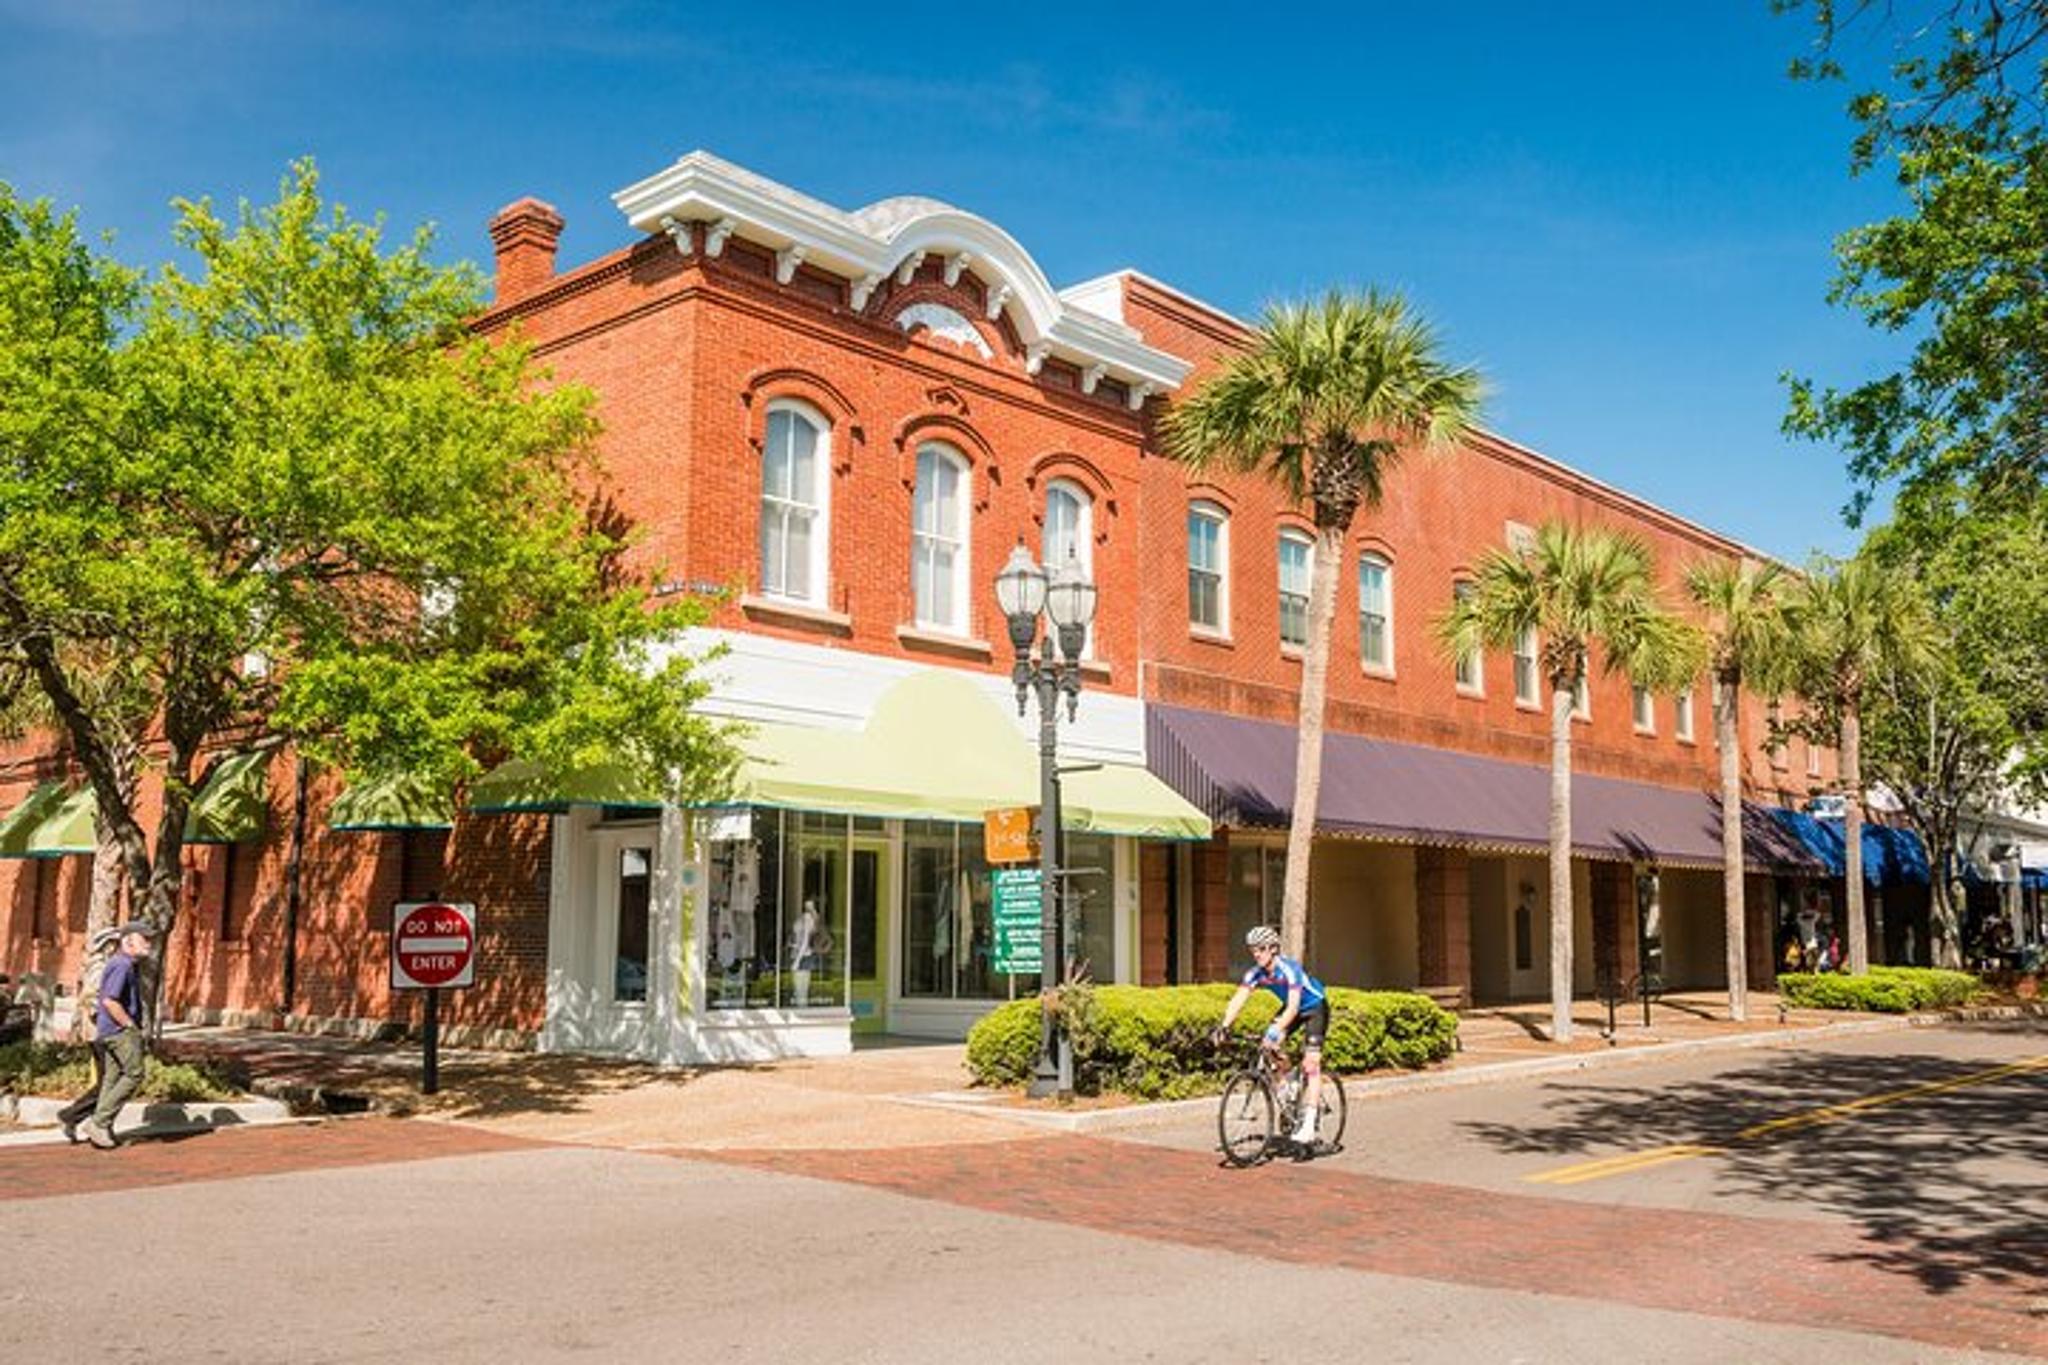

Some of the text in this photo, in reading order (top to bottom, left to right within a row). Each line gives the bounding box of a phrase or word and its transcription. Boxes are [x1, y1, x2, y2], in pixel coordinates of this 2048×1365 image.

[406, 919, 462, 933] DO NOT
[411, 955, 456, 970] ENTER
